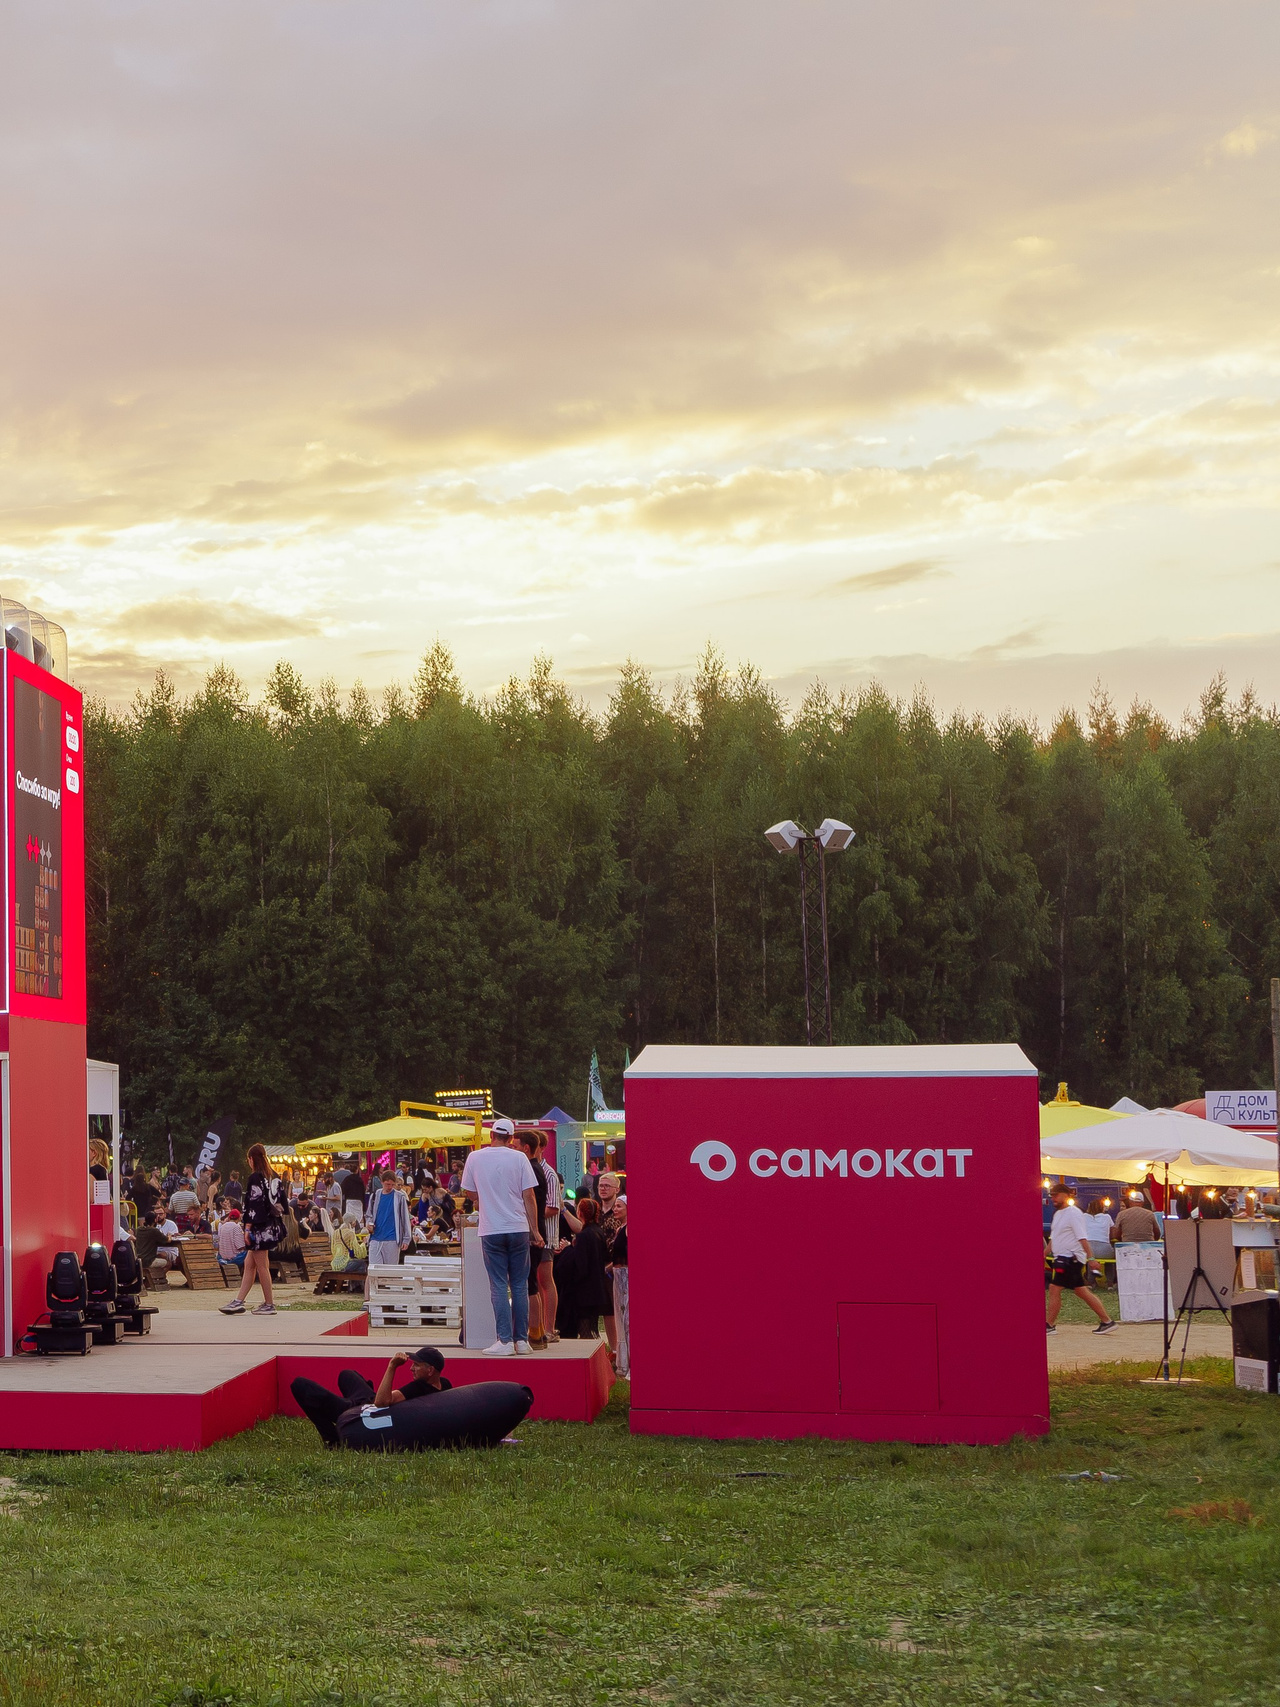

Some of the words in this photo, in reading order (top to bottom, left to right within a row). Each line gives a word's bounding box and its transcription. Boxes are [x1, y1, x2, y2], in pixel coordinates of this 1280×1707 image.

[16, 770, 41, 798] Спасибо
[40, 785, 48, 801] за
[47, 788, 61, 810] игру!
[1237, 1095, 1268, 1108] ДОМ
[596, 1112, 625, 1121] РОВЕСНИ
[1238, 1109, 1278, 1120] КУЛЬТ
[748, 1148, 973, 1178] самокат
